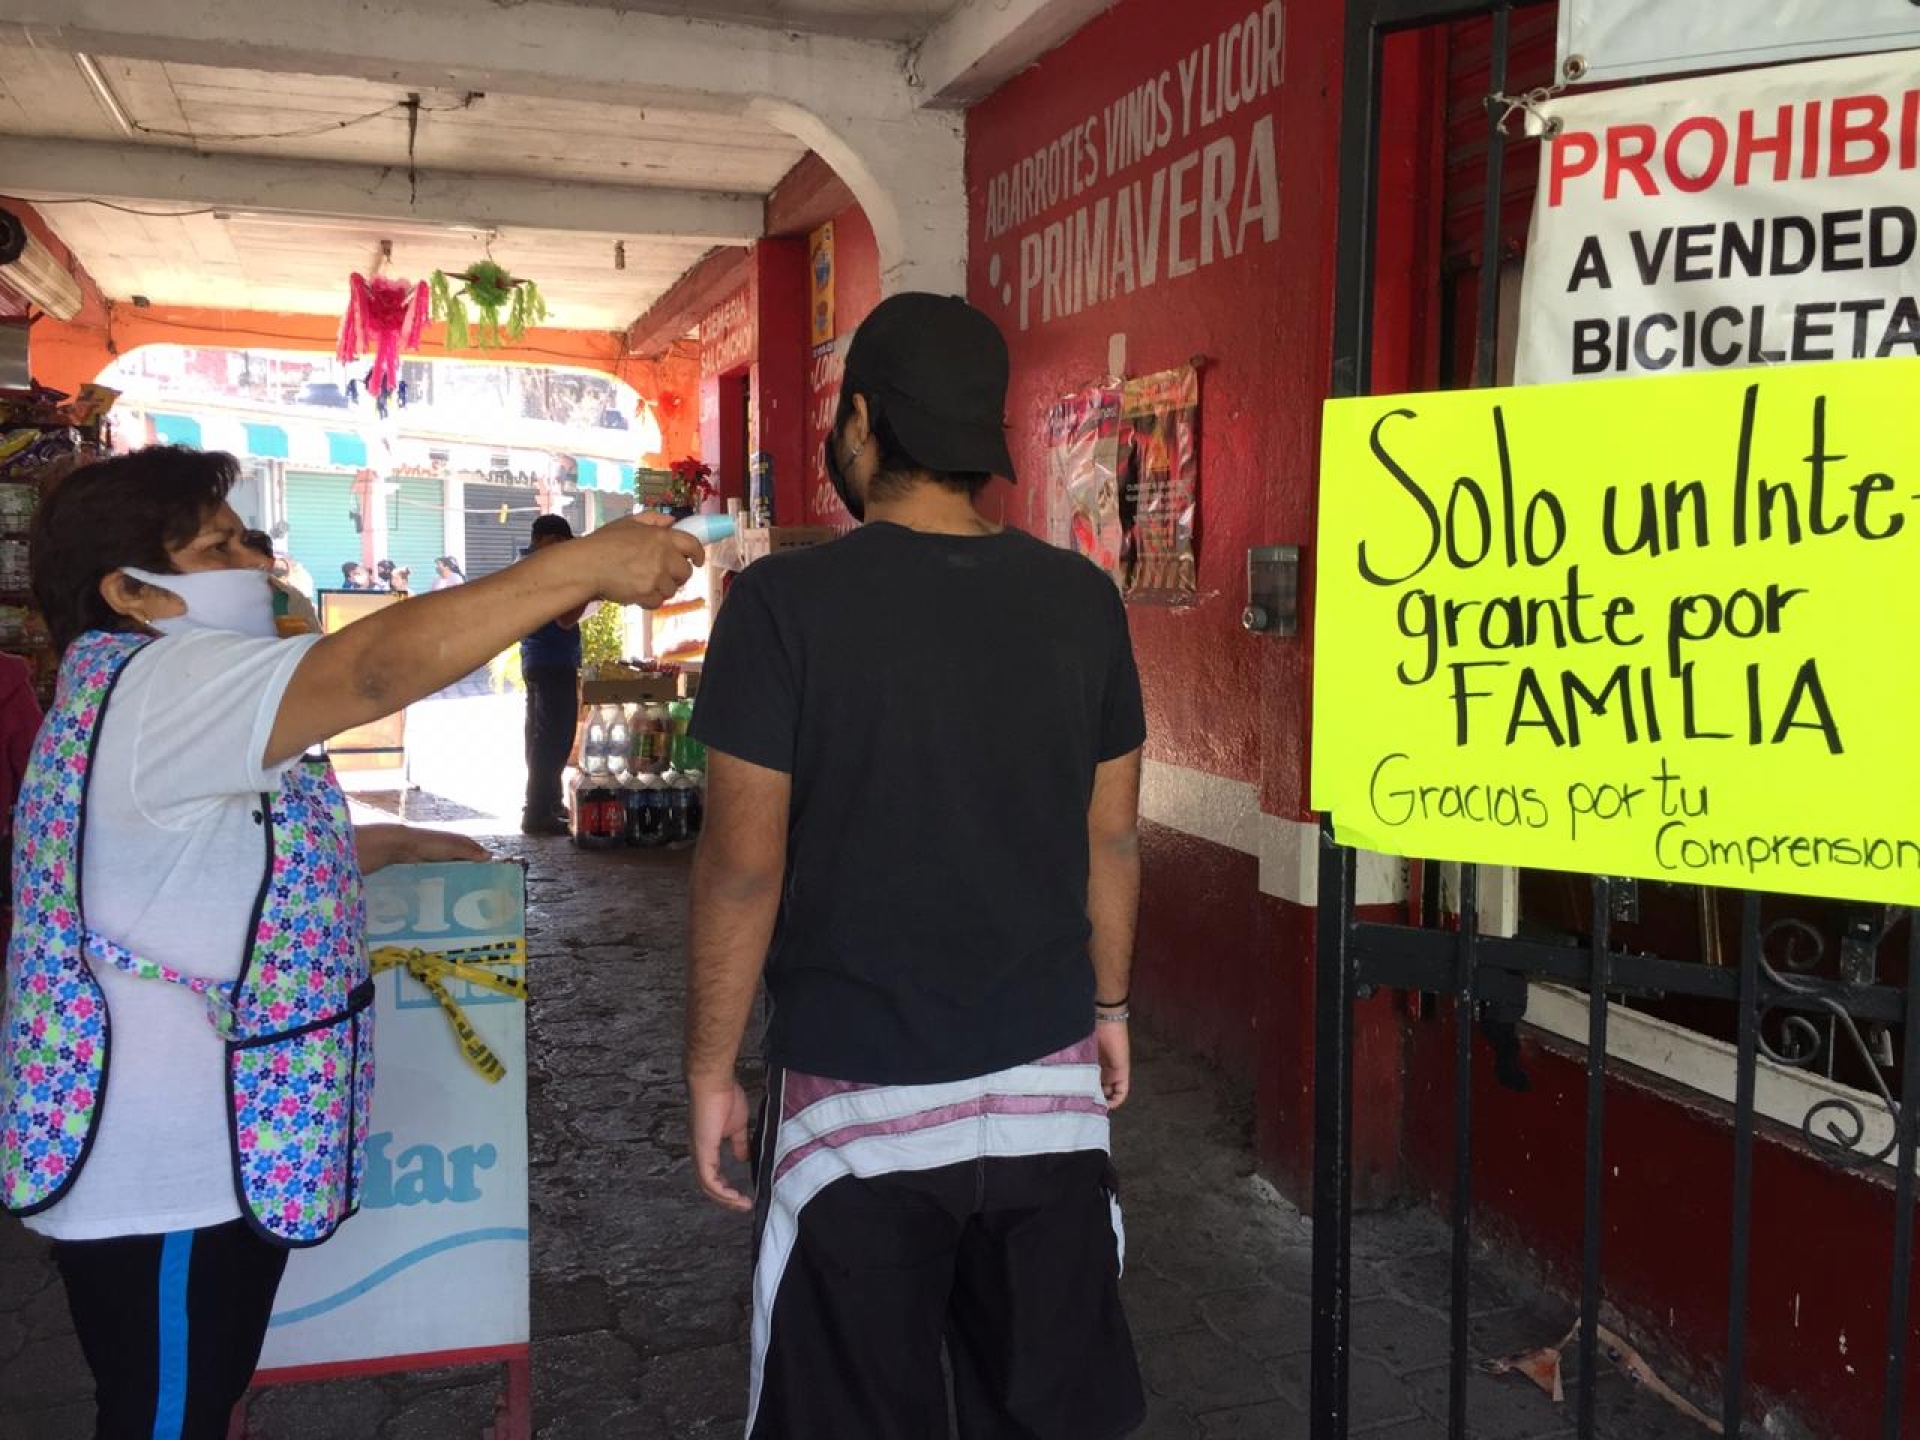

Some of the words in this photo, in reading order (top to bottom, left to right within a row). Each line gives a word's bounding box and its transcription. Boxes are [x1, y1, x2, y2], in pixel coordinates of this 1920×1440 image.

[985, 115, 1098, 243] ABARROTES
[1104, 69, 1171, 178] VINOS
[1177, 50, 1198, 137] Y
[1200, 0, 1286, 127] LICOR
[1548, 89, 1920, 208] PROHIBI
[1019, 113, 1281, 331] PRIMAVERA
[1566, 236, 1612, 292] A
[1629, 206, 1918, 286] VENDED
[1572, 296, 1920, 375] BICICLETA
[1358, 404, 1567, 586] Solo
[1602, 480, 1710, 558] un
[1396, 564, 1644, 685] grante
[1668, 584, 1809, 679] por
[1447, 658, 1845, 755] FAMILIA
[1369, 753, 1549, 828] Gracias
[1567, 780, 1646, 841] por
[1651, 757, 1708, 817] tu
[1656, 820, 1920, 874] Comprension
